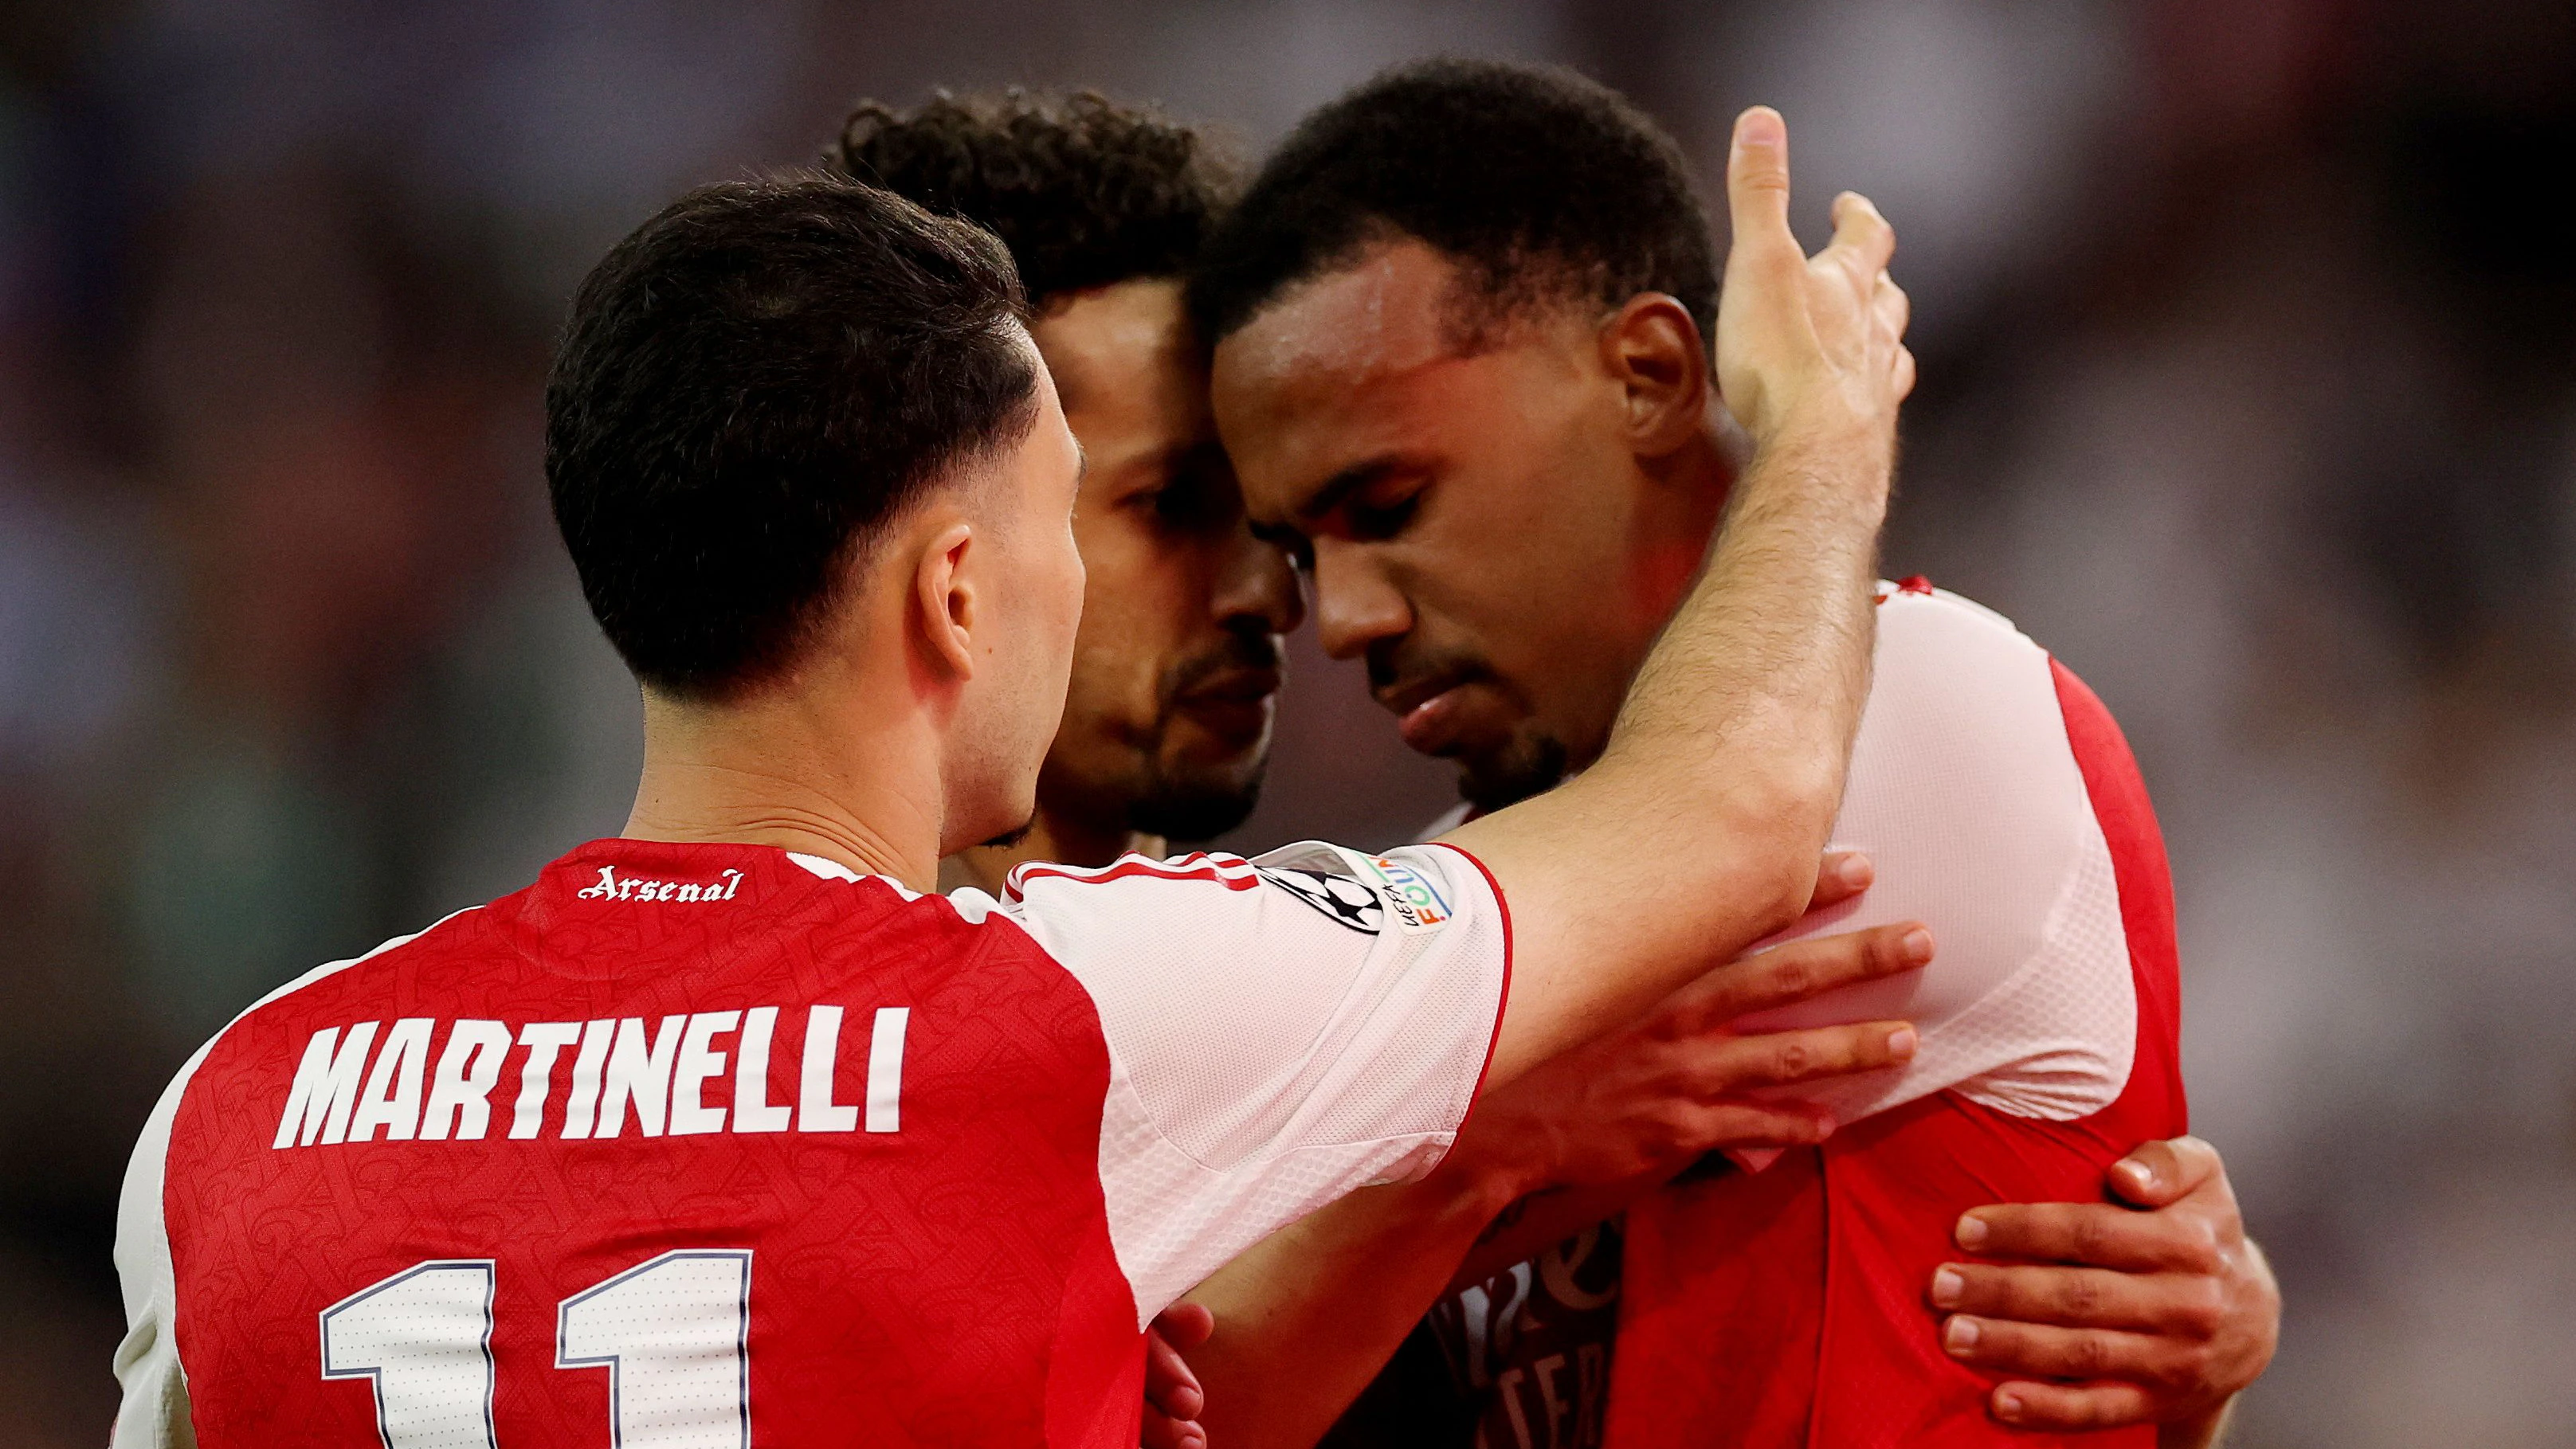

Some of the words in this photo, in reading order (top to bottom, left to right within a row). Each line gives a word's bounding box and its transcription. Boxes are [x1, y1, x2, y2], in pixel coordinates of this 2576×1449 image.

[577, 865, 744, 903] Arsenal
[1381, 883, 1420, 927] UEFA
[272, 1005, 911, 1149] MARTINELLI
[320, 1248, 754, 1449] 11
